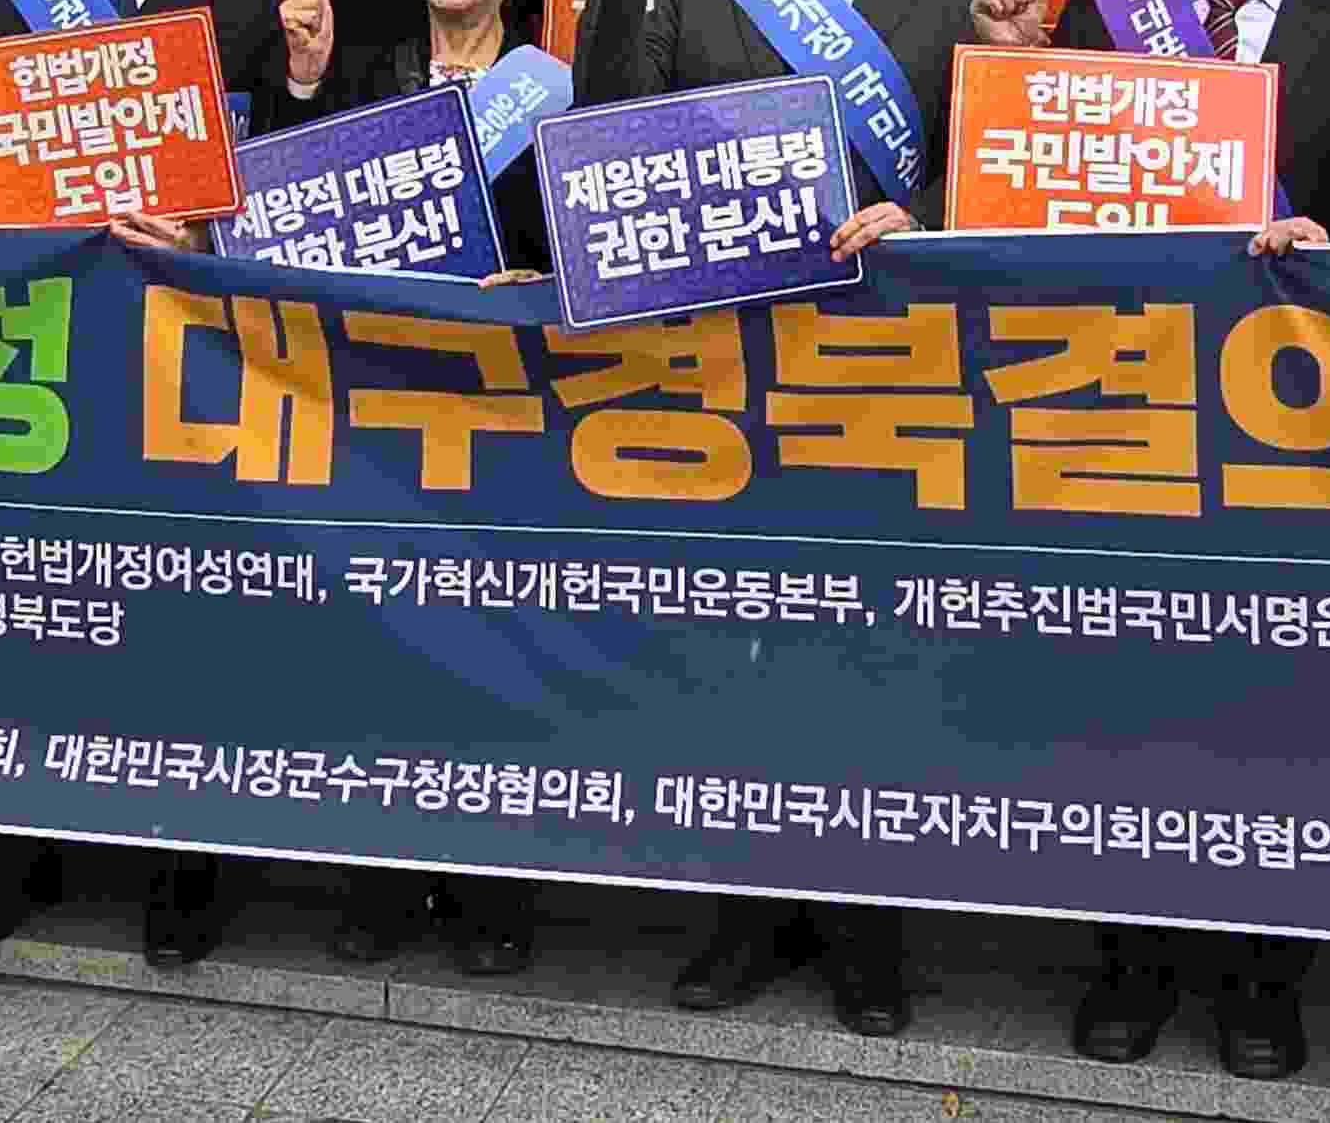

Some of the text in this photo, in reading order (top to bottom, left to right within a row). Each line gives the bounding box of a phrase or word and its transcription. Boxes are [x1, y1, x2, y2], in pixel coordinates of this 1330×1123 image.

[10, 37, 158, 103] 헌법개정
[1024, 70, 1200, 129] 헌법개정
[53, 154, 160, 216] 도입!
[231, 136, 465, 240] 제왕적 대통령
[562, 127, 828, 212] 제왕적 대통령
[976, 128, 1246, 202] 국민발안제
[353, 195, 464, 272] 분산!
[586, 186, 821, 279] 권한 분산!
[0, 534, 328, 605] 헌법개정여성연대,
[343, 555, 876, 627] 국가혁신개헌국민운동본부,
[43, 734, 636, 826] 대한민국시장군수구청장협의회,
